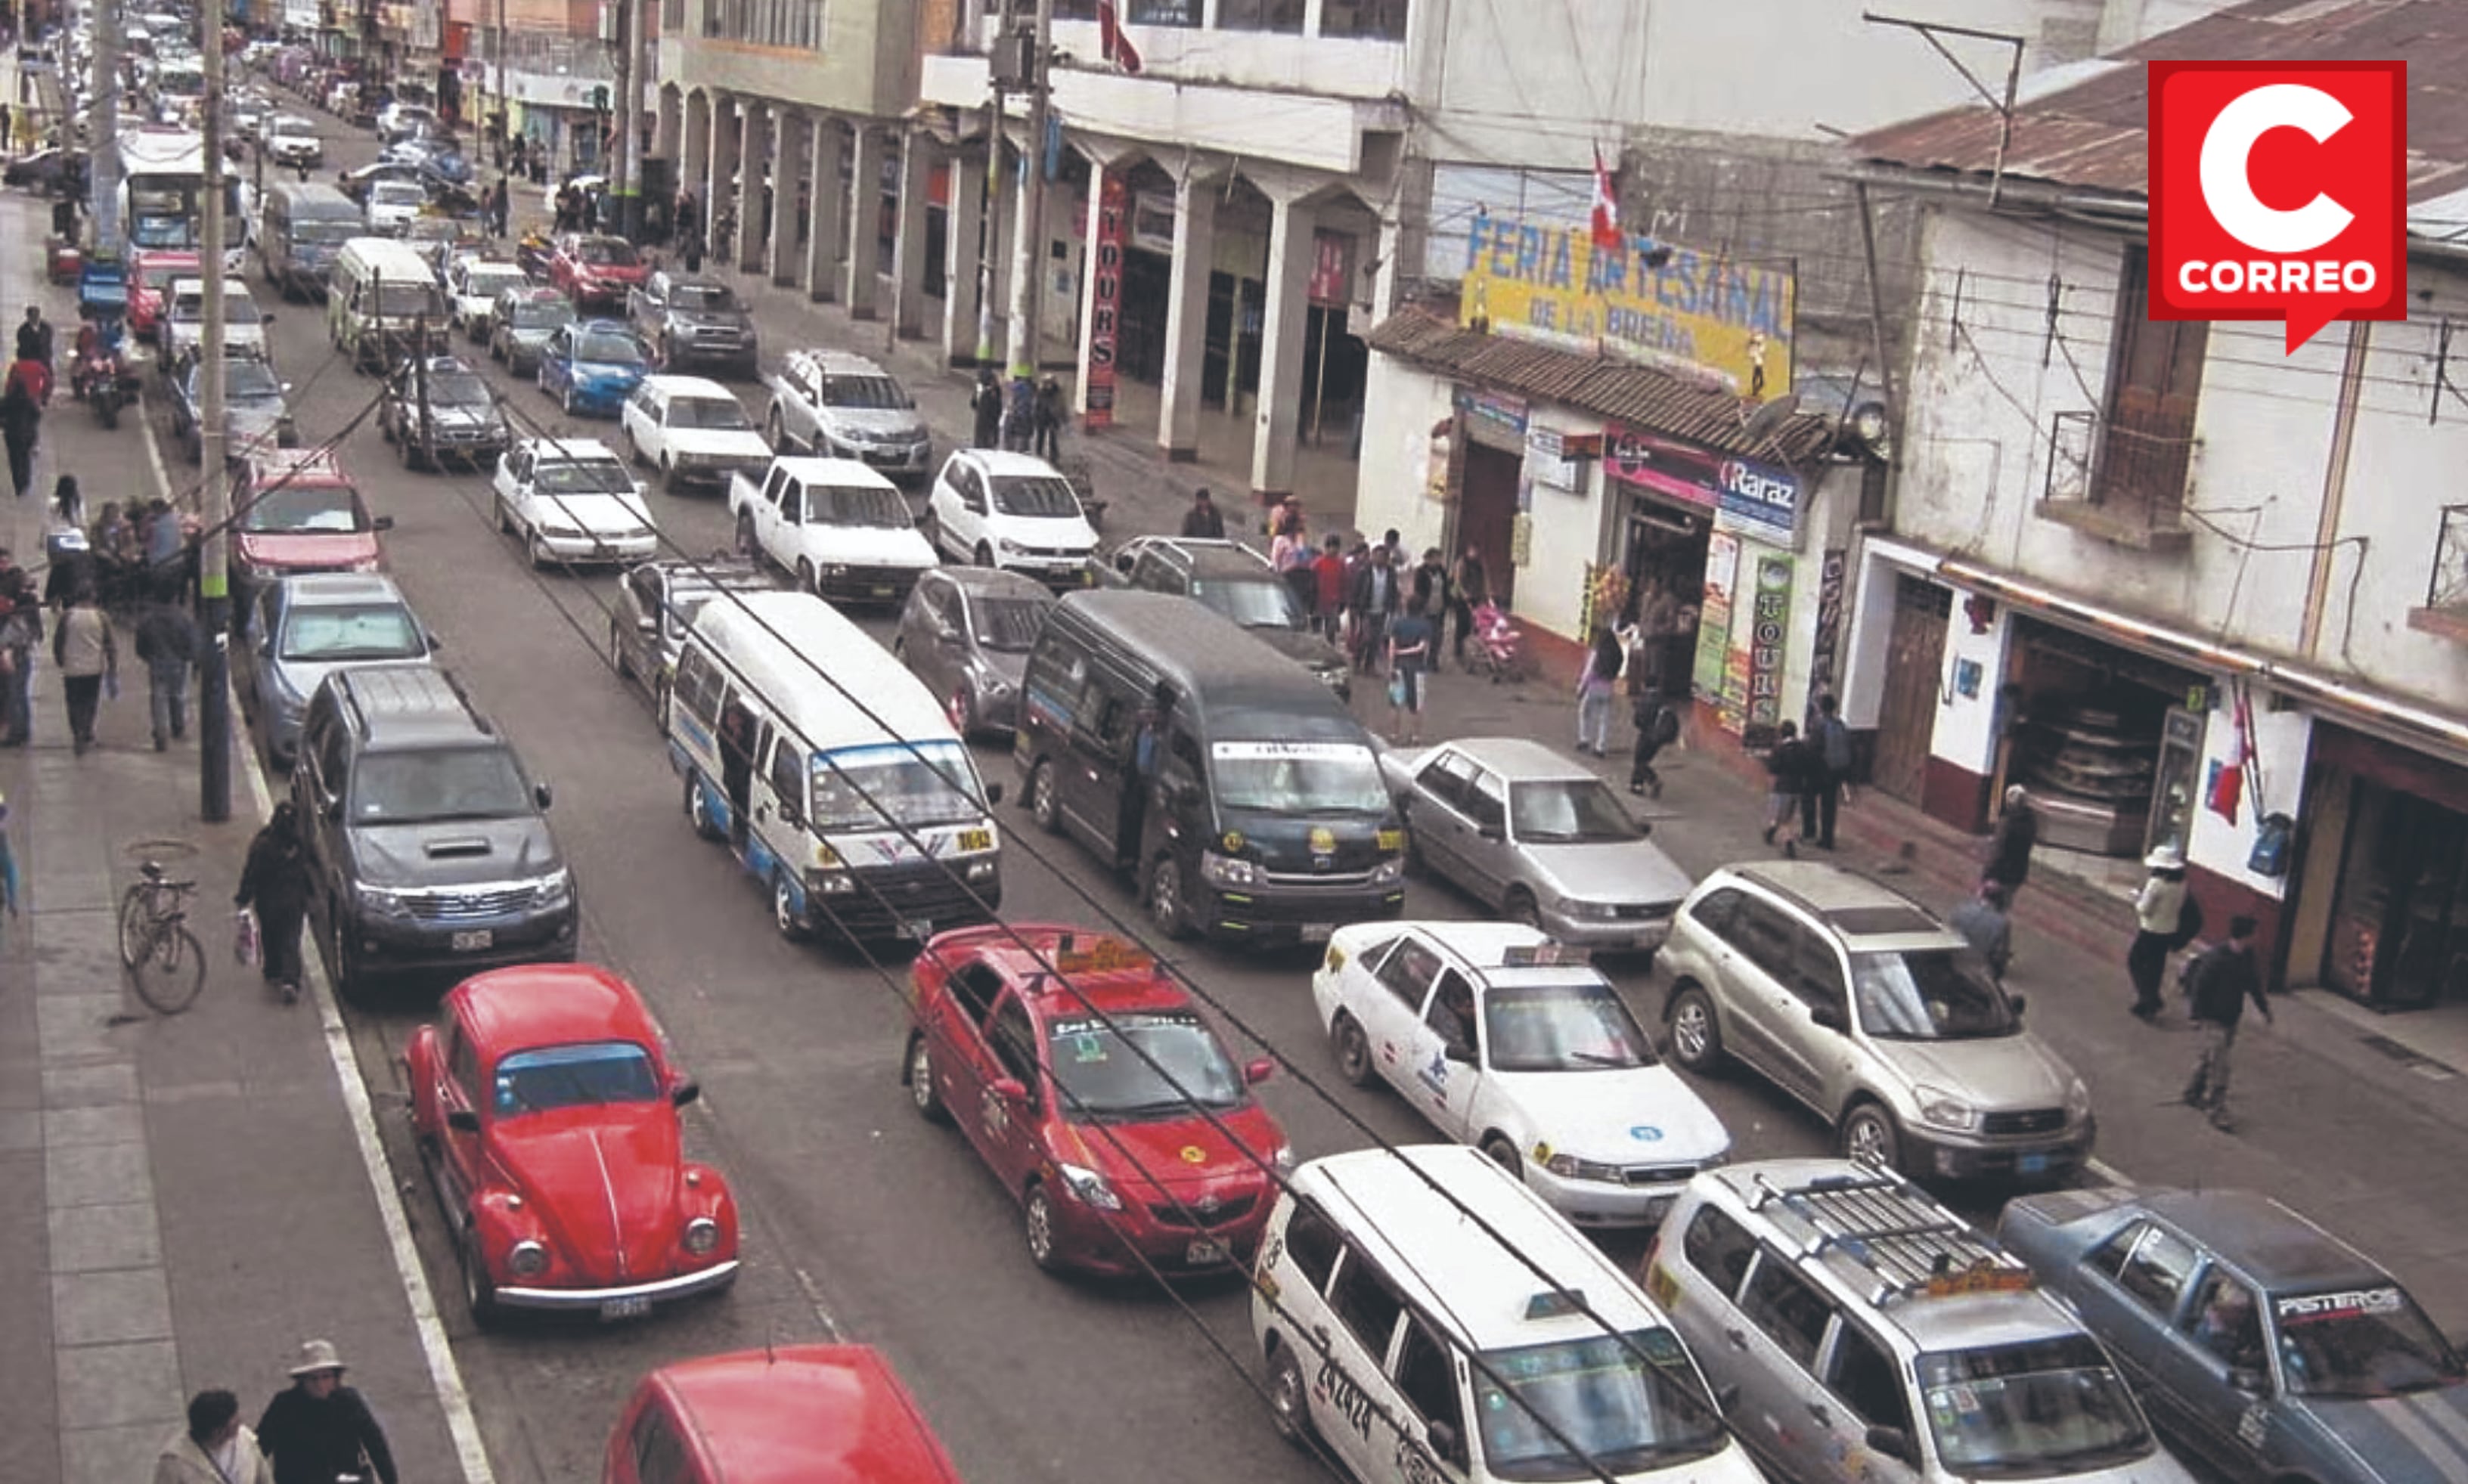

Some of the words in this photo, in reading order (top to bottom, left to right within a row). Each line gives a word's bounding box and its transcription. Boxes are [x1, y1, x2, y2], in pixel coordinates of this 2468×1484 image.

[1091, 207, 1122, 366] TOURS
[1468, 214, 1573, 290] FERIA
[1586, 235, 1791, 343] ARTESANAL
[1530, 296, 1557, 330] DE
[1564, 304, 1598, 337] LA
[1753, 593, 1784, 718] TOURS
